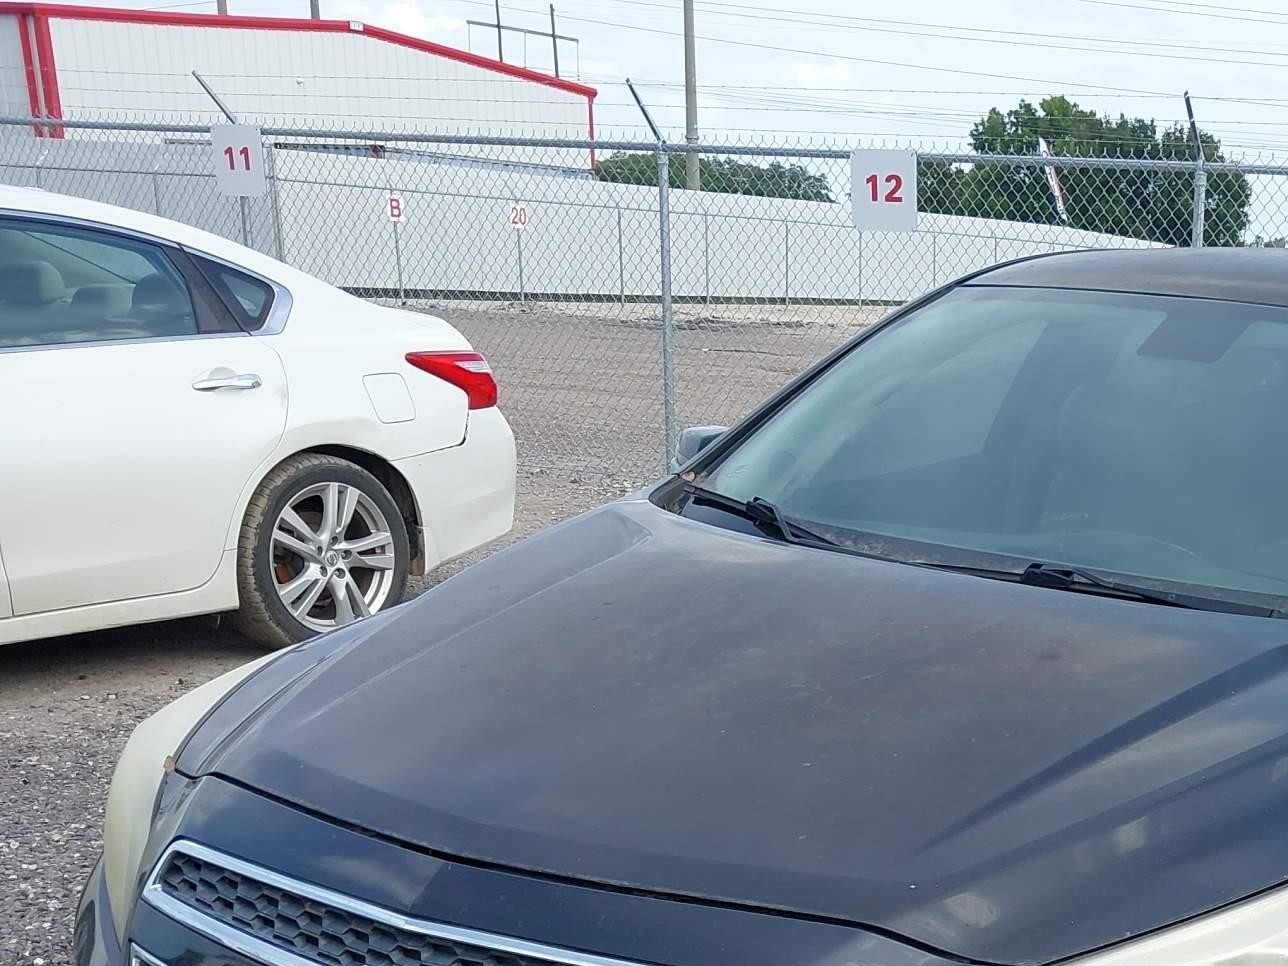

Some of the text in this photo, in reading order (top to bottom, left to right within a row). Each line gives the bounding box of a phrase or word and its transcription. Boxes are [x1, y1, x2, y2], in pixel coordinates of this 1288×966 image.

[223, 146, 251, 171] 11
[865, 174, 904, 203] 12
[389, 199, 402, 218] B
[511, 207, 527, 225] 20
